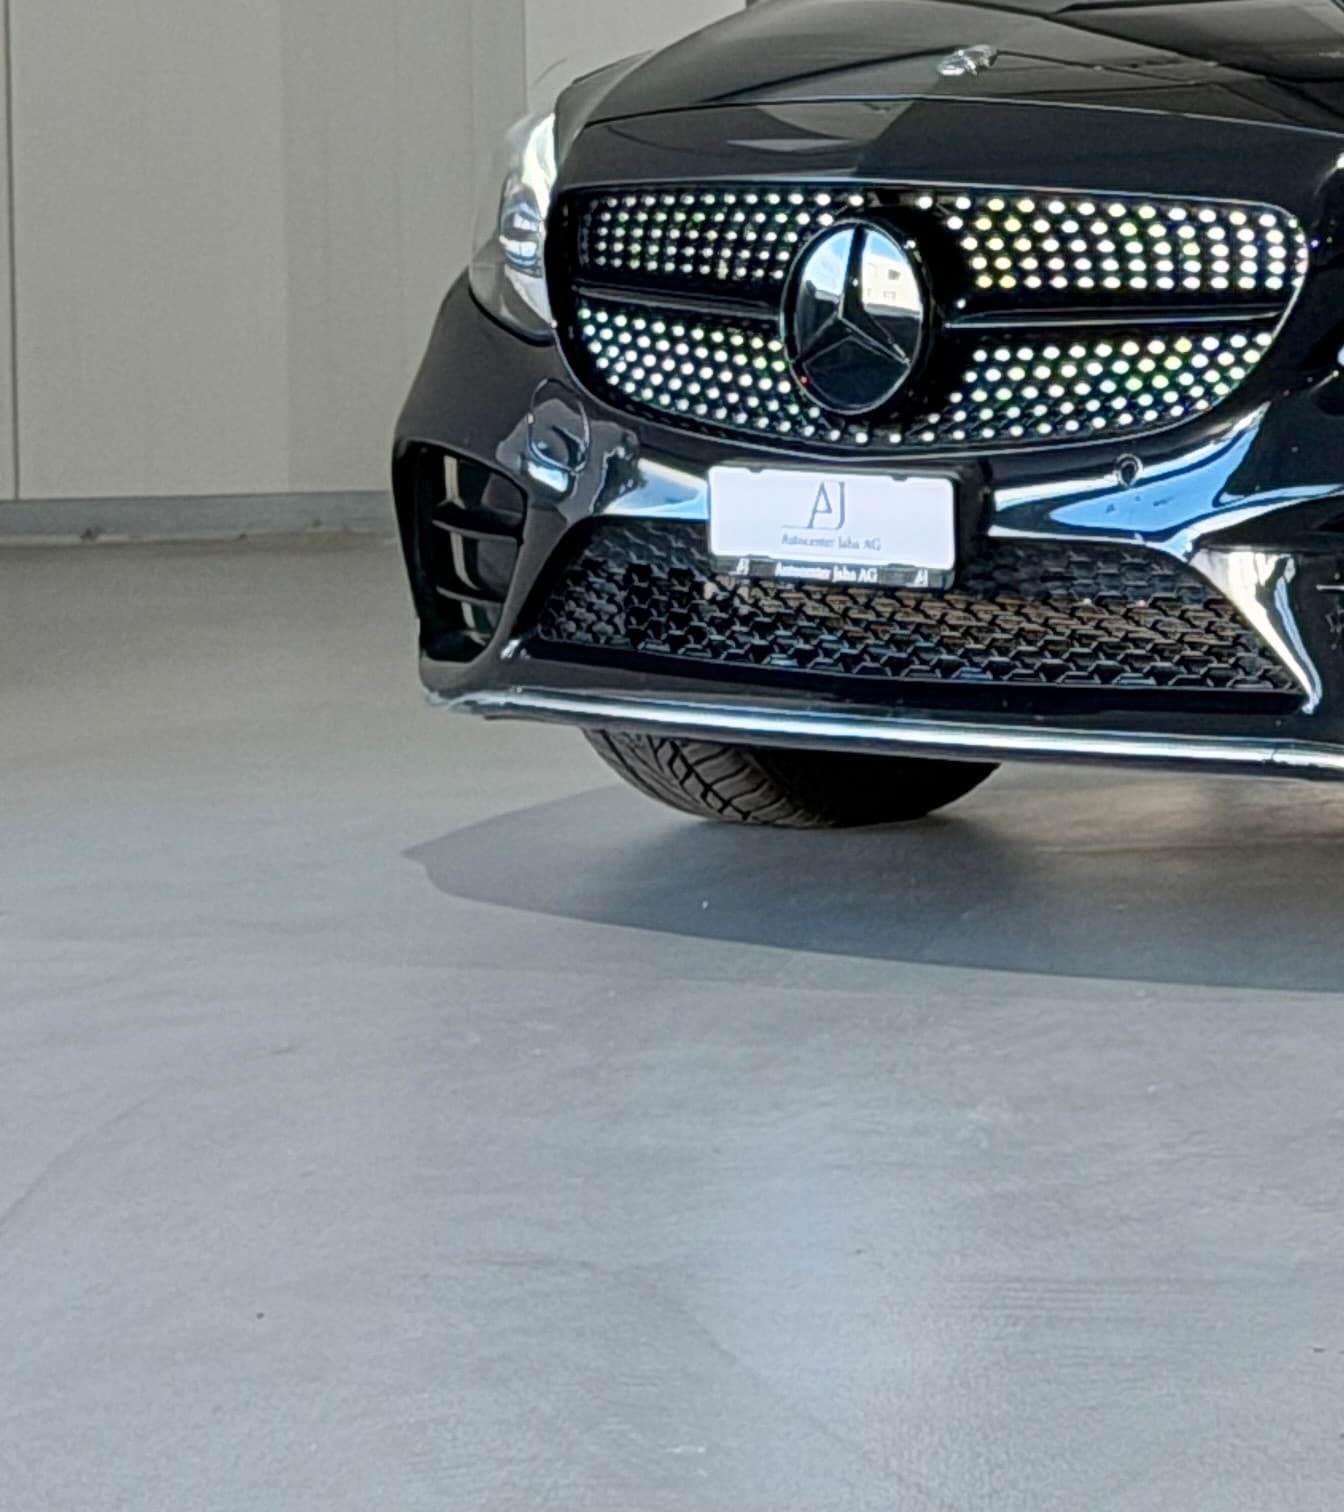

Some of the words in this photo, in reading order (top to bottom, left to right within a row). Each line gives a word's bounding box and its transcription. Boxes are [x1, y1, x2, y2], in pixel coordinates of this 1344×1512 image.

[806, 479, 846, 531] AJ
[863, 537, 882, 552] AG
[857, 567, 879, 584] AG
